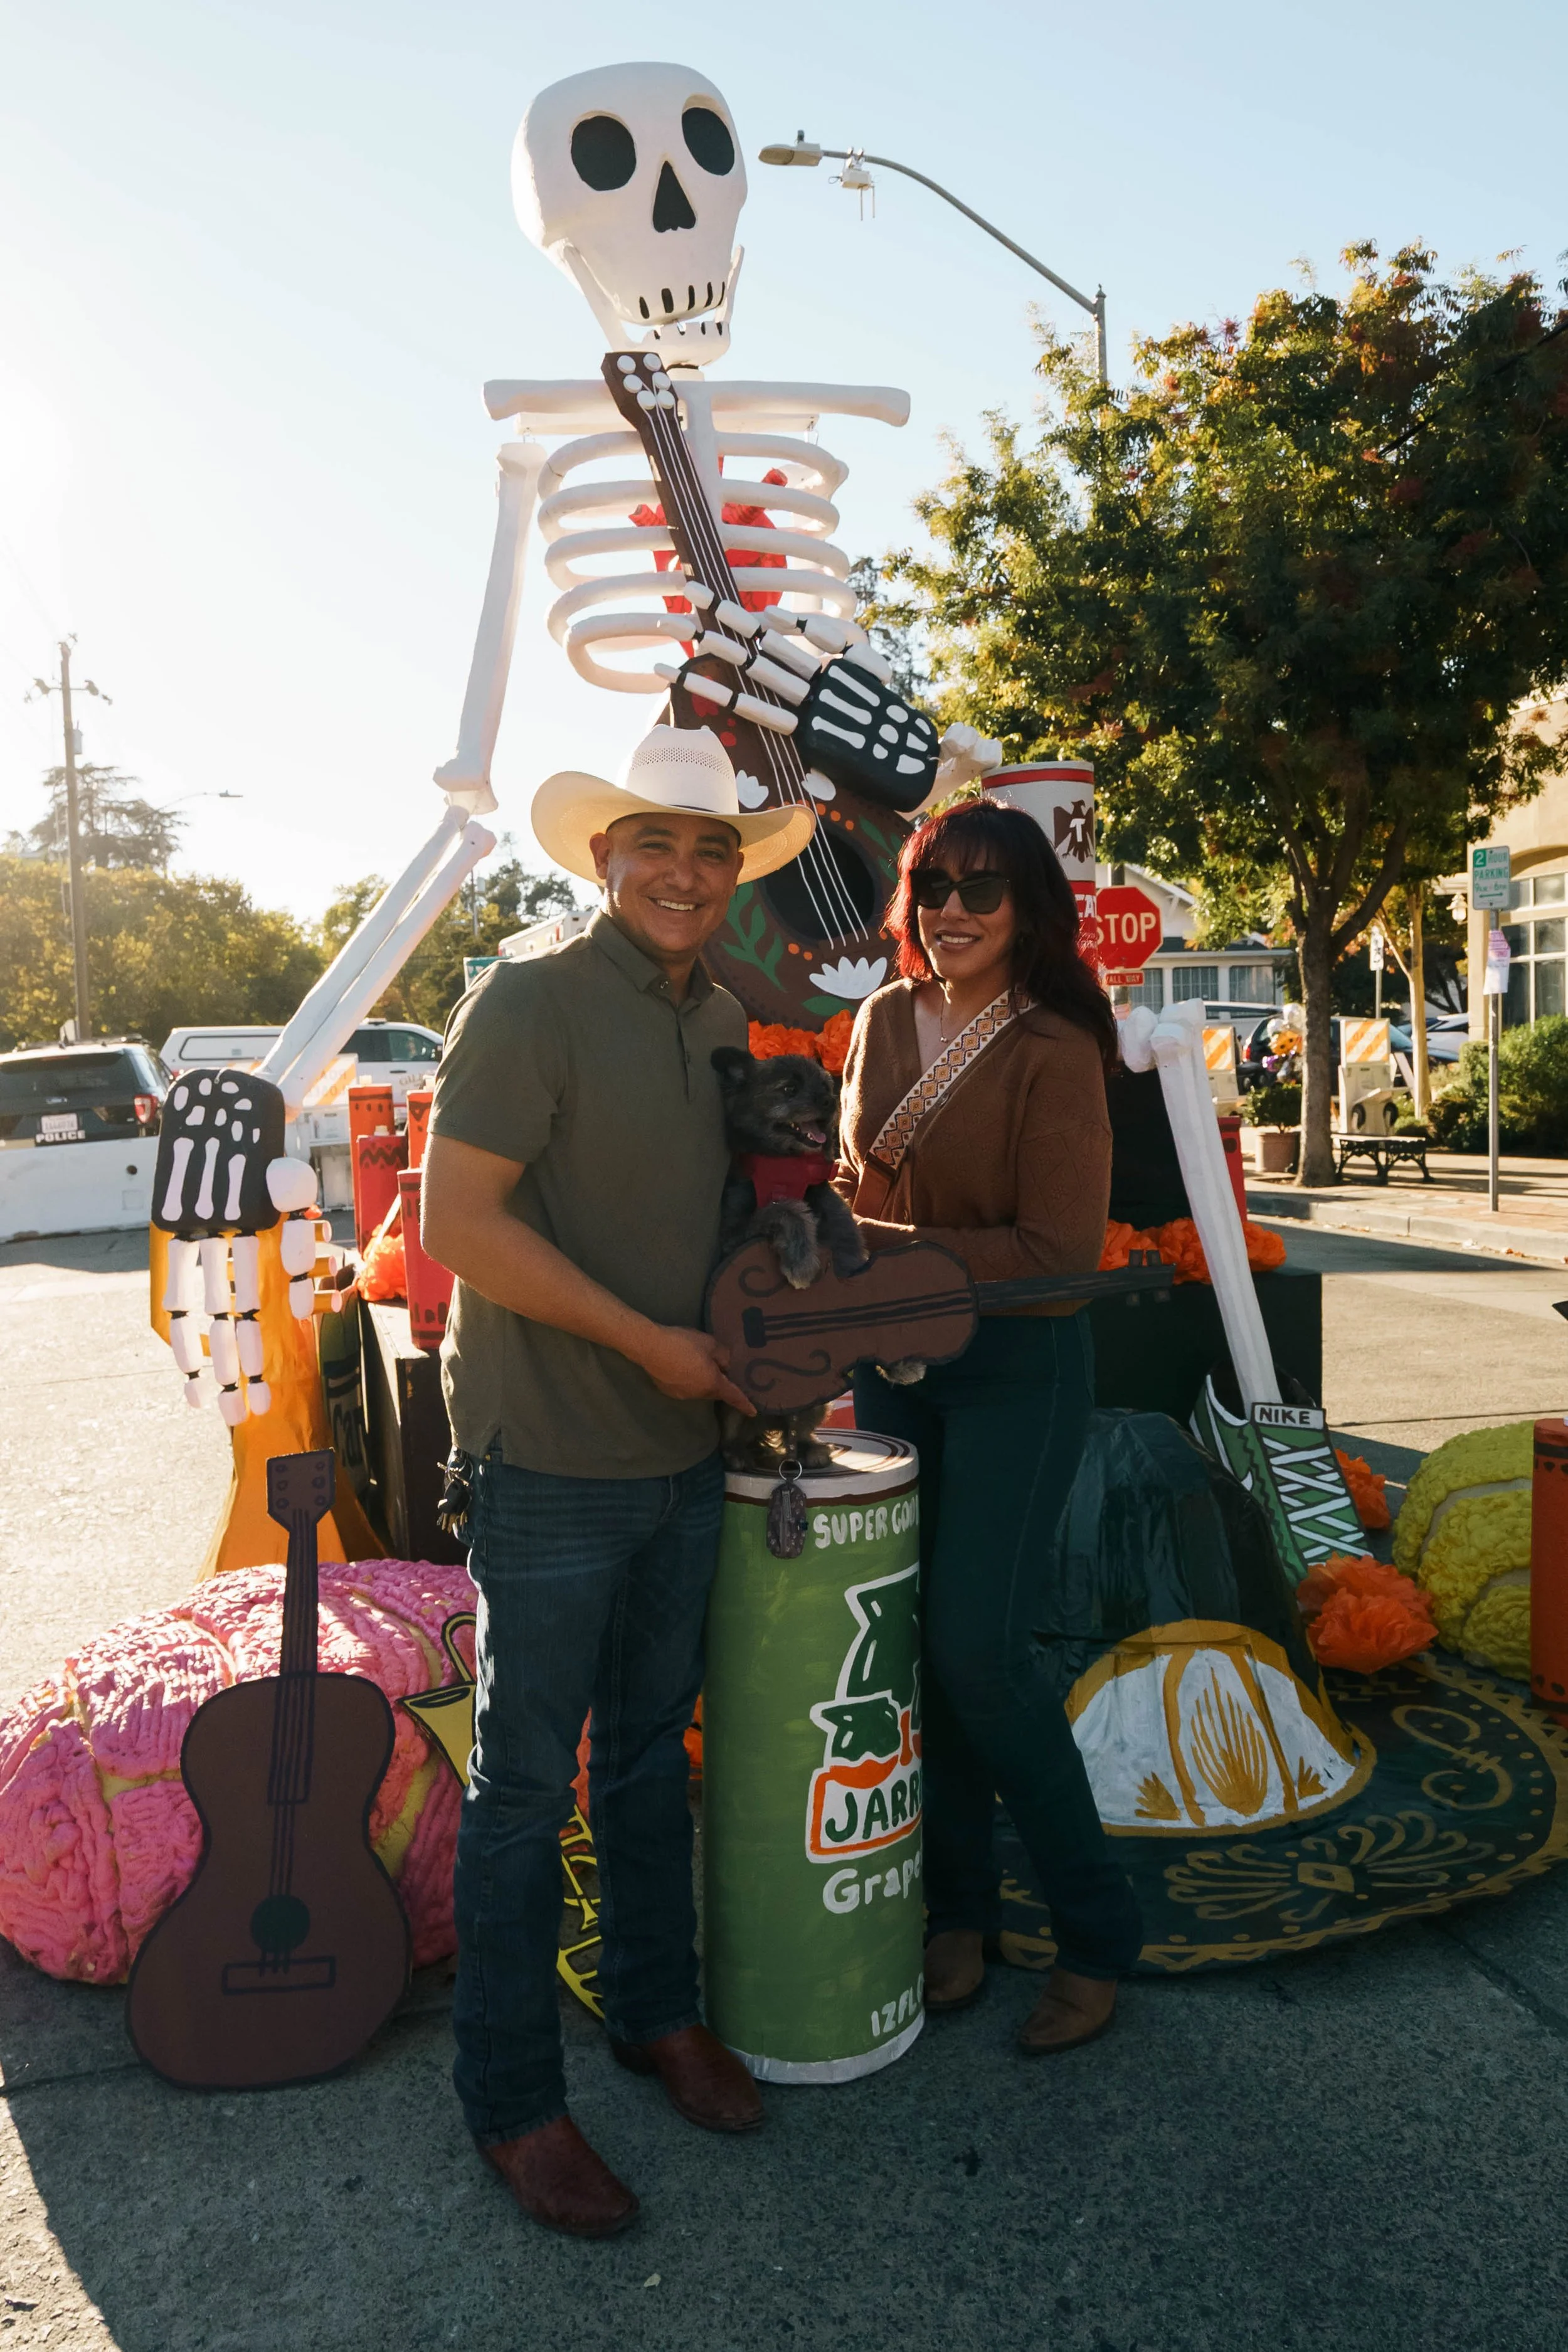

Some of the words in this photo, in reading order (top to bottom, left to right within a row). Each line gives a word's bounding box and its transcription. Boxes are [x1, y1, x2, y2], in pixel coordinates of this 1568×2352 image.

[1476, 852, 1484, 865] 2
[36, 1130, 85, 1143] POLICE
[1259, 1407, 1311, 1425] NIKE
[813, 1506, 888, 1549] SUPER
[825, 1770, 921, 1843] JARR
